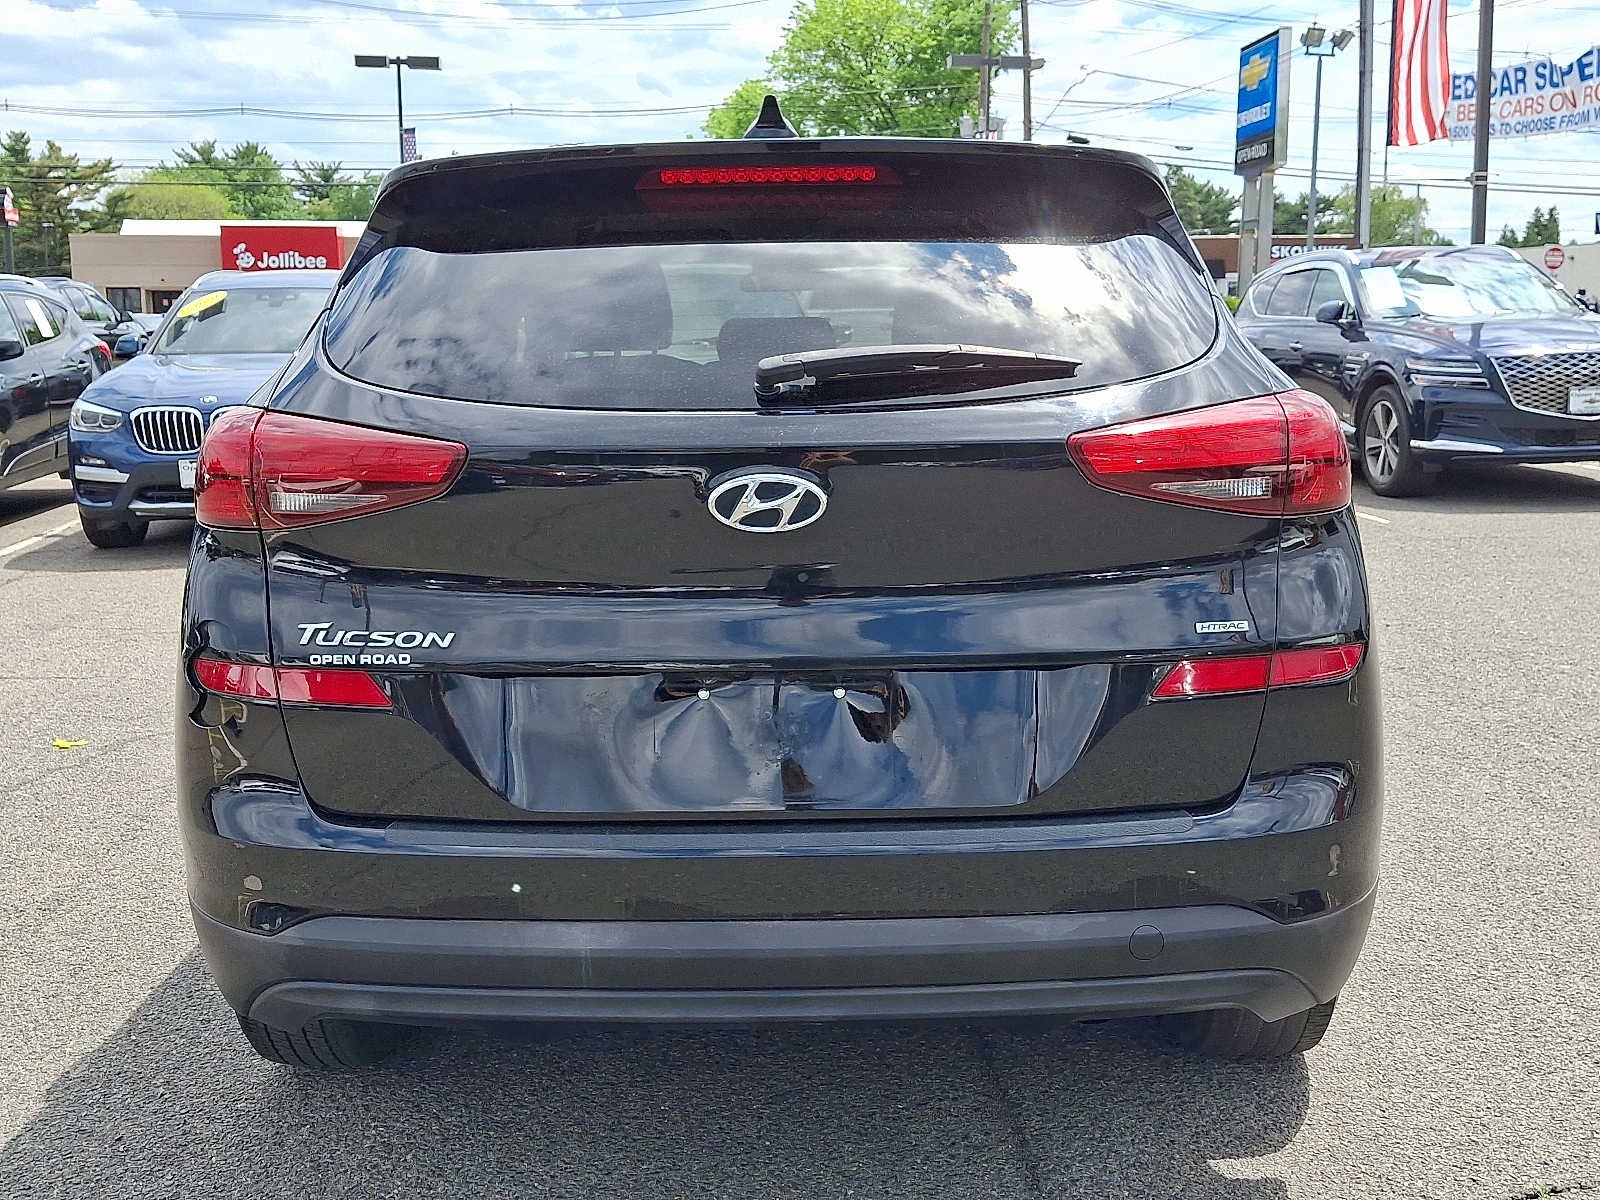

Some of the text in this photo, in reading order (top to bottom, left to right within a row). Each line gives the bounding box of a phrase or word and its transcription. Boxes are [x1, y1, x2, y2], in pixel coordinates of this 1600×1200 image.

[1534, 48, 1600, 91] SUPE
[1499, 95, 1544, 120] CARS
[1549, 89, 1577, 113] ON
[1513, 116, 1557, 134] CHOOSE
[1559, 109, 1590, 130] FROM
[256, 250, 328, 269] Jollibee
[297, 621, 456, 648] TUCSON
[1200, 622, 1245, 631] HTRAC
[309, 653, 411, 666] OPEN ROAD
